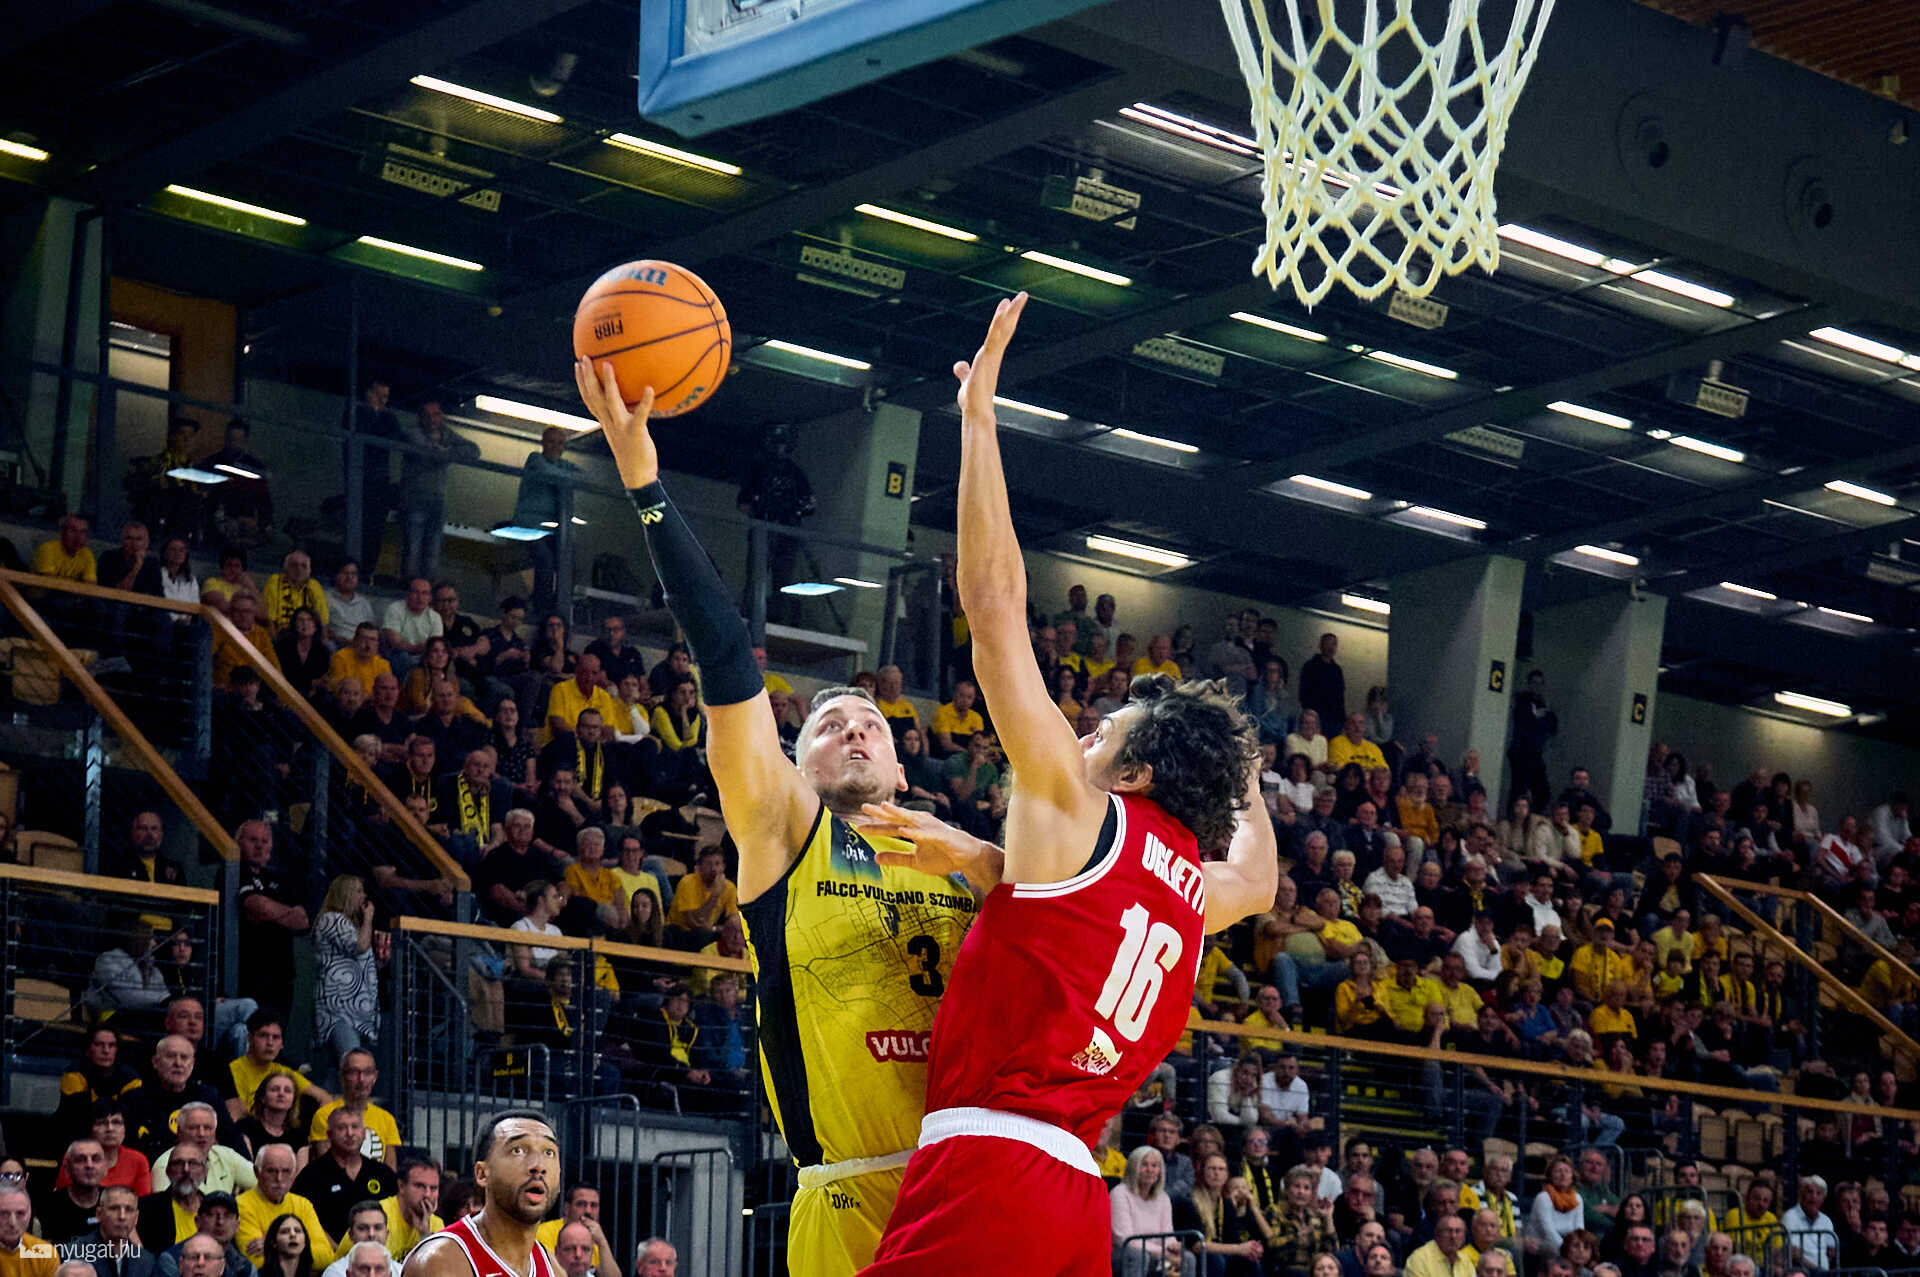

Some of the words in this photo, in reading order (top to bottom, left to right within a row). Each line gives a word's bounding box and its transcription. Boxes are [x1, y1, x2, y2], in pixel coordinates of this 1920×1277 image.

[594, 319, 624, 341] FIBA
[889, 473, 902, 494] B
[1491, 669, 1503, 689] C
[1633, 703, 1645, 721] C
[816, 879, 925, 905] FALCO-VULCANO
[907, 934, 945, 997] 3
[1094, 901, 1183, 1042] 16
